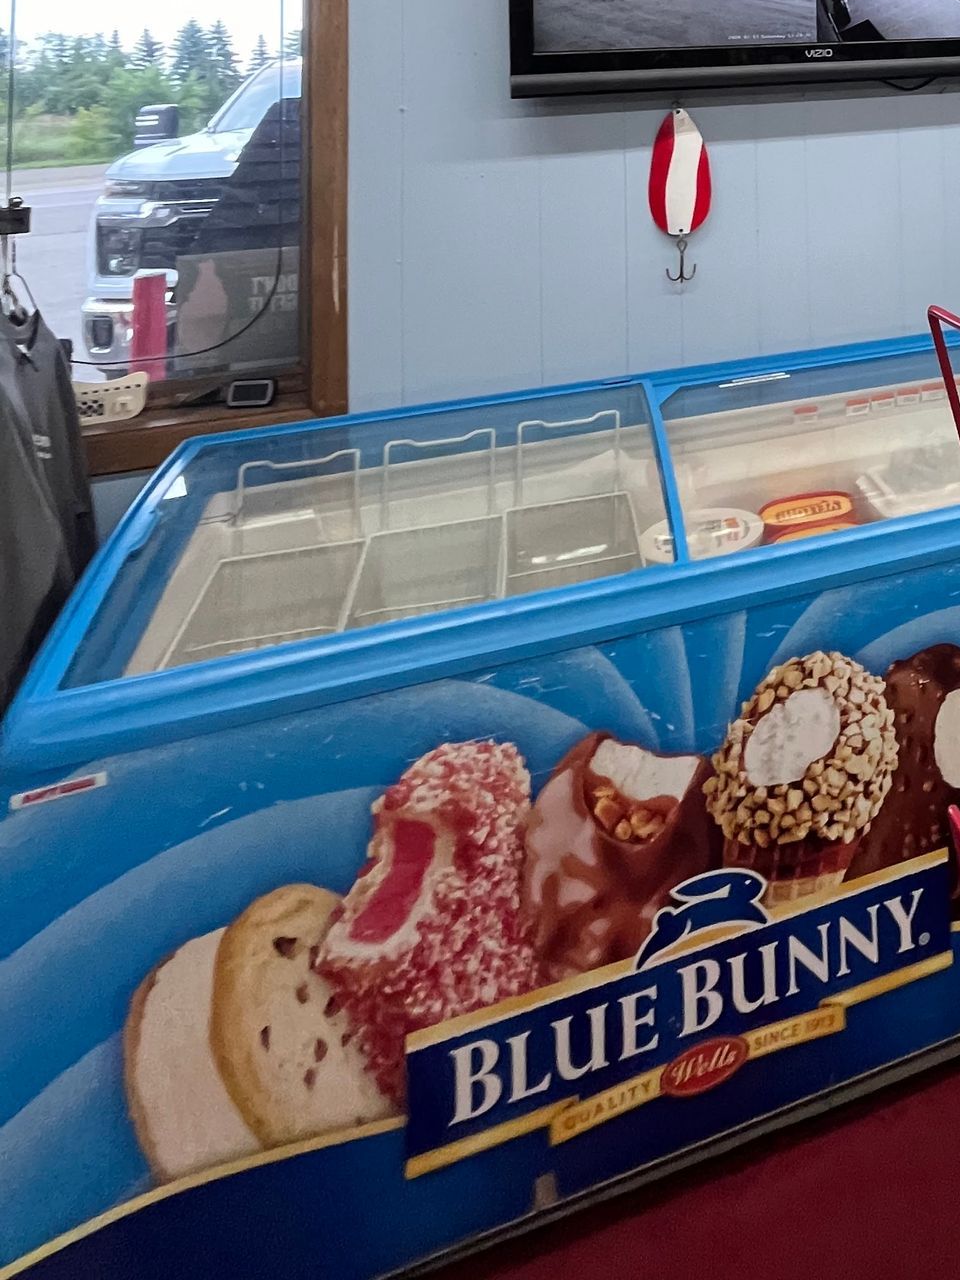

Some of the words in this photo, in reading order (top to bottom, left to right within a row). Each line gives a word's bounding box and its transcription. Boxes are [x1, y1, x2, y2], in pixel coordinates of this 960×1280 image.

[805, 48, 833, 58] VIZIO
[448, 986, 660, 1126] BLUE
[676, 888, 925, 1039] BUNNY
[563, 1081, 651, 1130] QUALITY
[671, 1043, 737, 1087] Wells
[754, 1025, 800, 1051] SINCE
